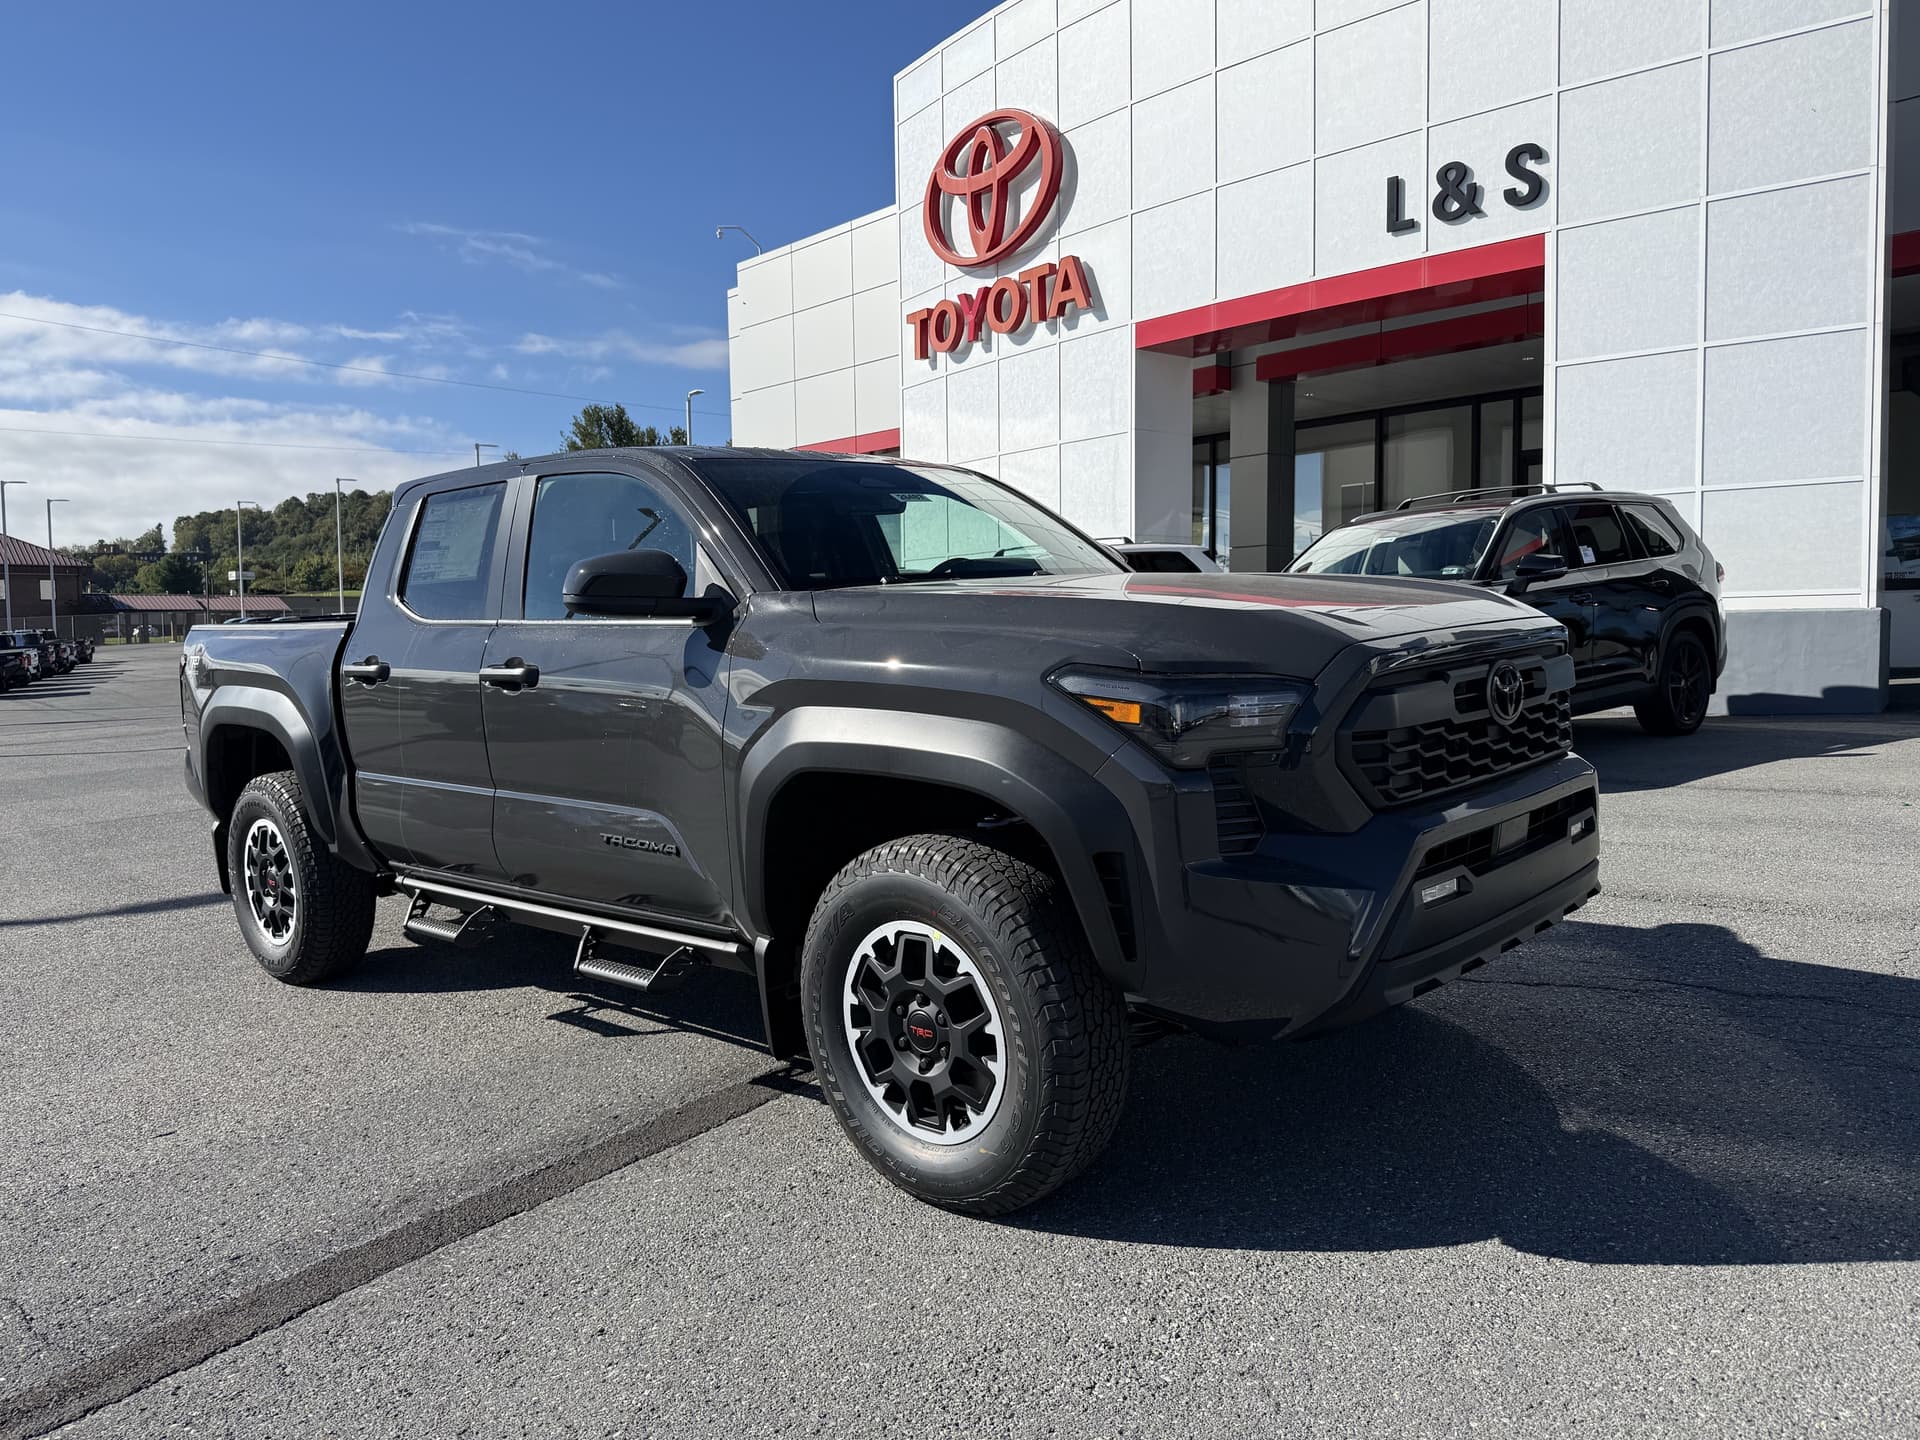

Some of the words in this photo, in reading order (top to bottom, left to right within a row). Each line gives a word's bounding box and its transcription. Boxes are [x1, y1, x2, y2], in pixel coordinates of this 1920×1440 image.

[1387, 176, 1415, 233] L
[1432, 161, 1482, 222] &
[1503, 143, 1543, 207] S
[906, 255, 1094, 360] TOYOTA
[599, 832, 680, 857] TACOMA
[909, 1025, 934, 1038] TRD
